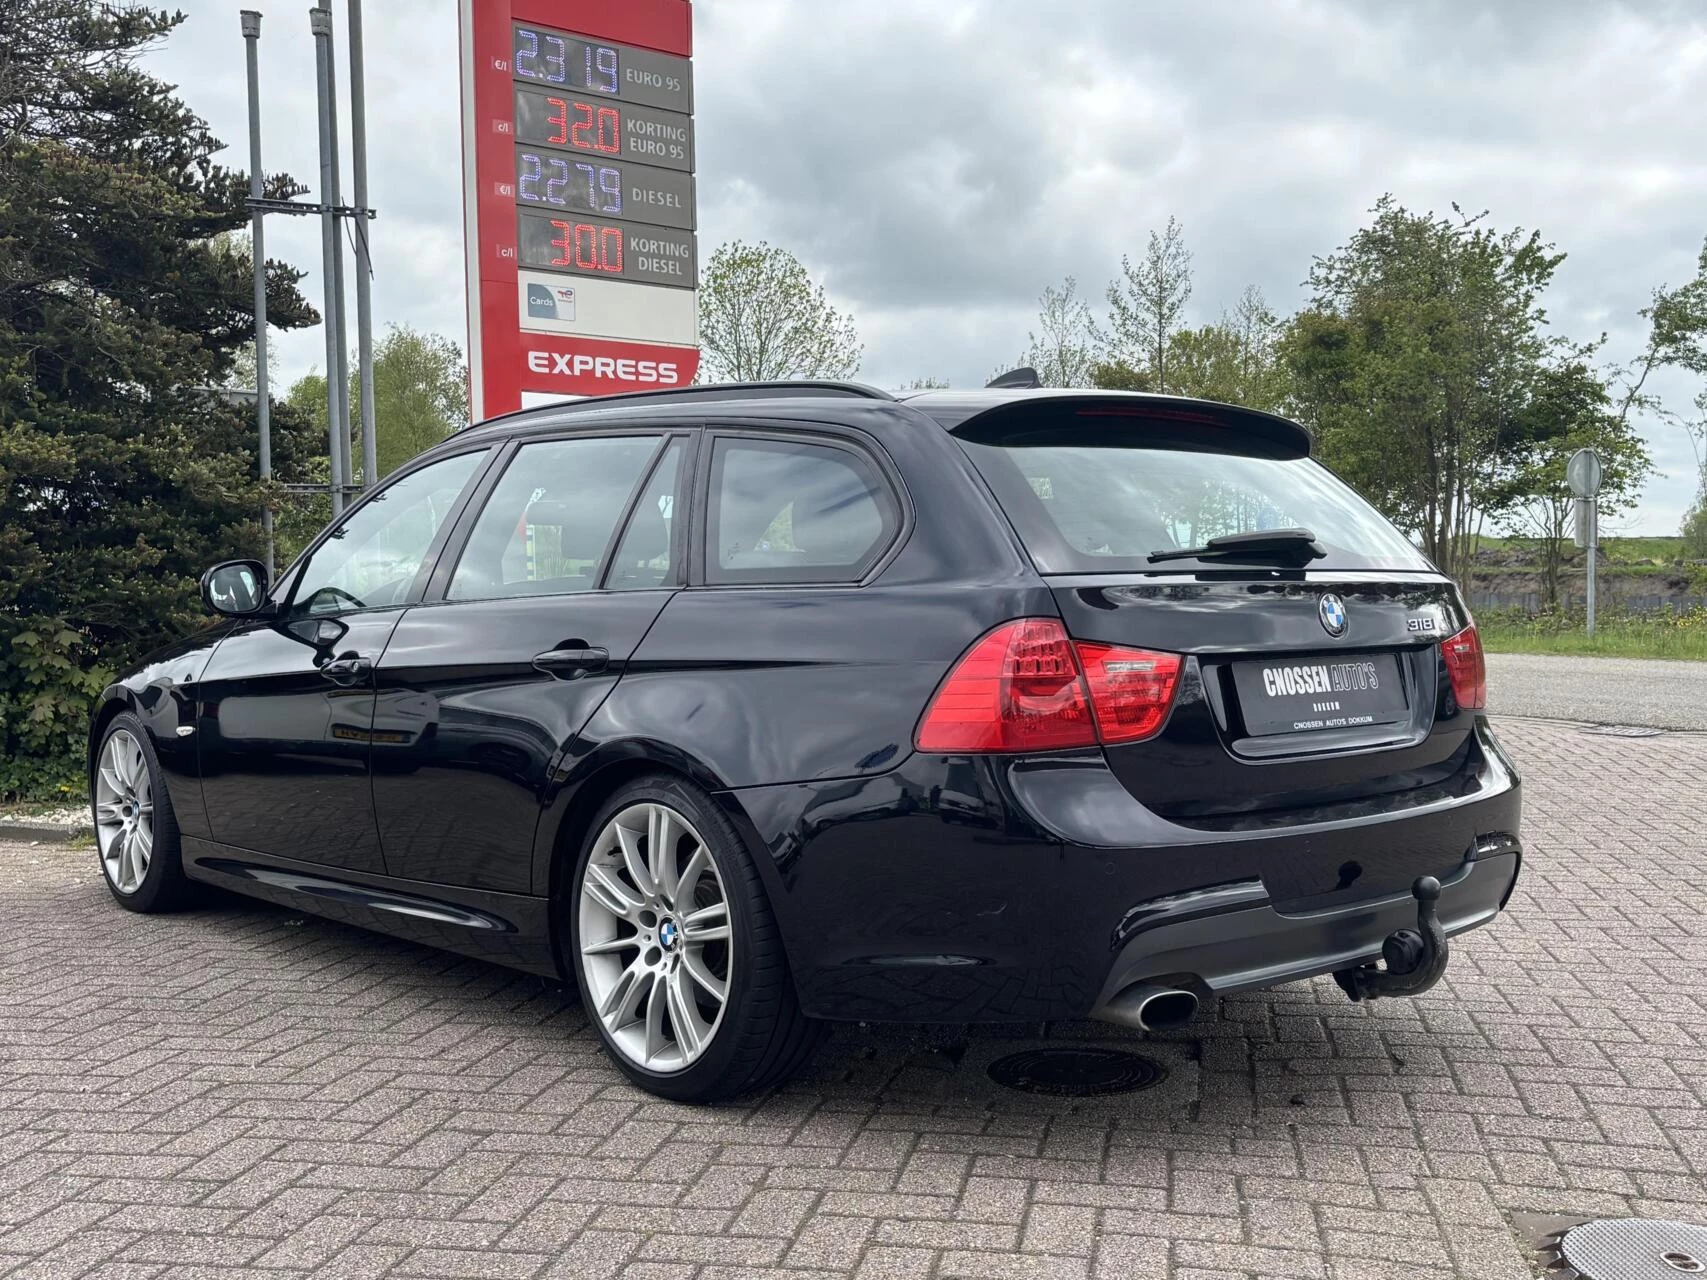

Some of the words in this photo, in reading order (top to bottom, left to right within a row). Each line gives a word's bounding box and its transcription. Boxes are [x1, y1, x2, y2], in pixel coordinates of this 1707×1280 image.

[516, 30, 617, 93] 2.319
[626, 68, 662, 87] EURO
[665, 77, 681, 91] 95
[547, 97, 620, 153] 32.0
[627, 119, 686, 142] KORTING
[630, 137, 667, 155] EURO
[670, 145, 684, 159] 95
[519, 154, 621, 212] 2.279
[632, 187, 682, 208] DIESEL
[550, 219, 623, 273] 30.0
[630, 237, 689, 258] KORTING
[638, 256, 682, 275] DIESEL
[530, 296, 554, 306] Cards
[528, 351, 678, 384] EXPRESS
[1263, 665, 1331, 696] CNOSSEN
[1331, 662, 1379, 692] AUTO'S
[1294, 720, 1323, 729] CNOSSEN
[1348, 715, 1373, 724] DOKKUM
